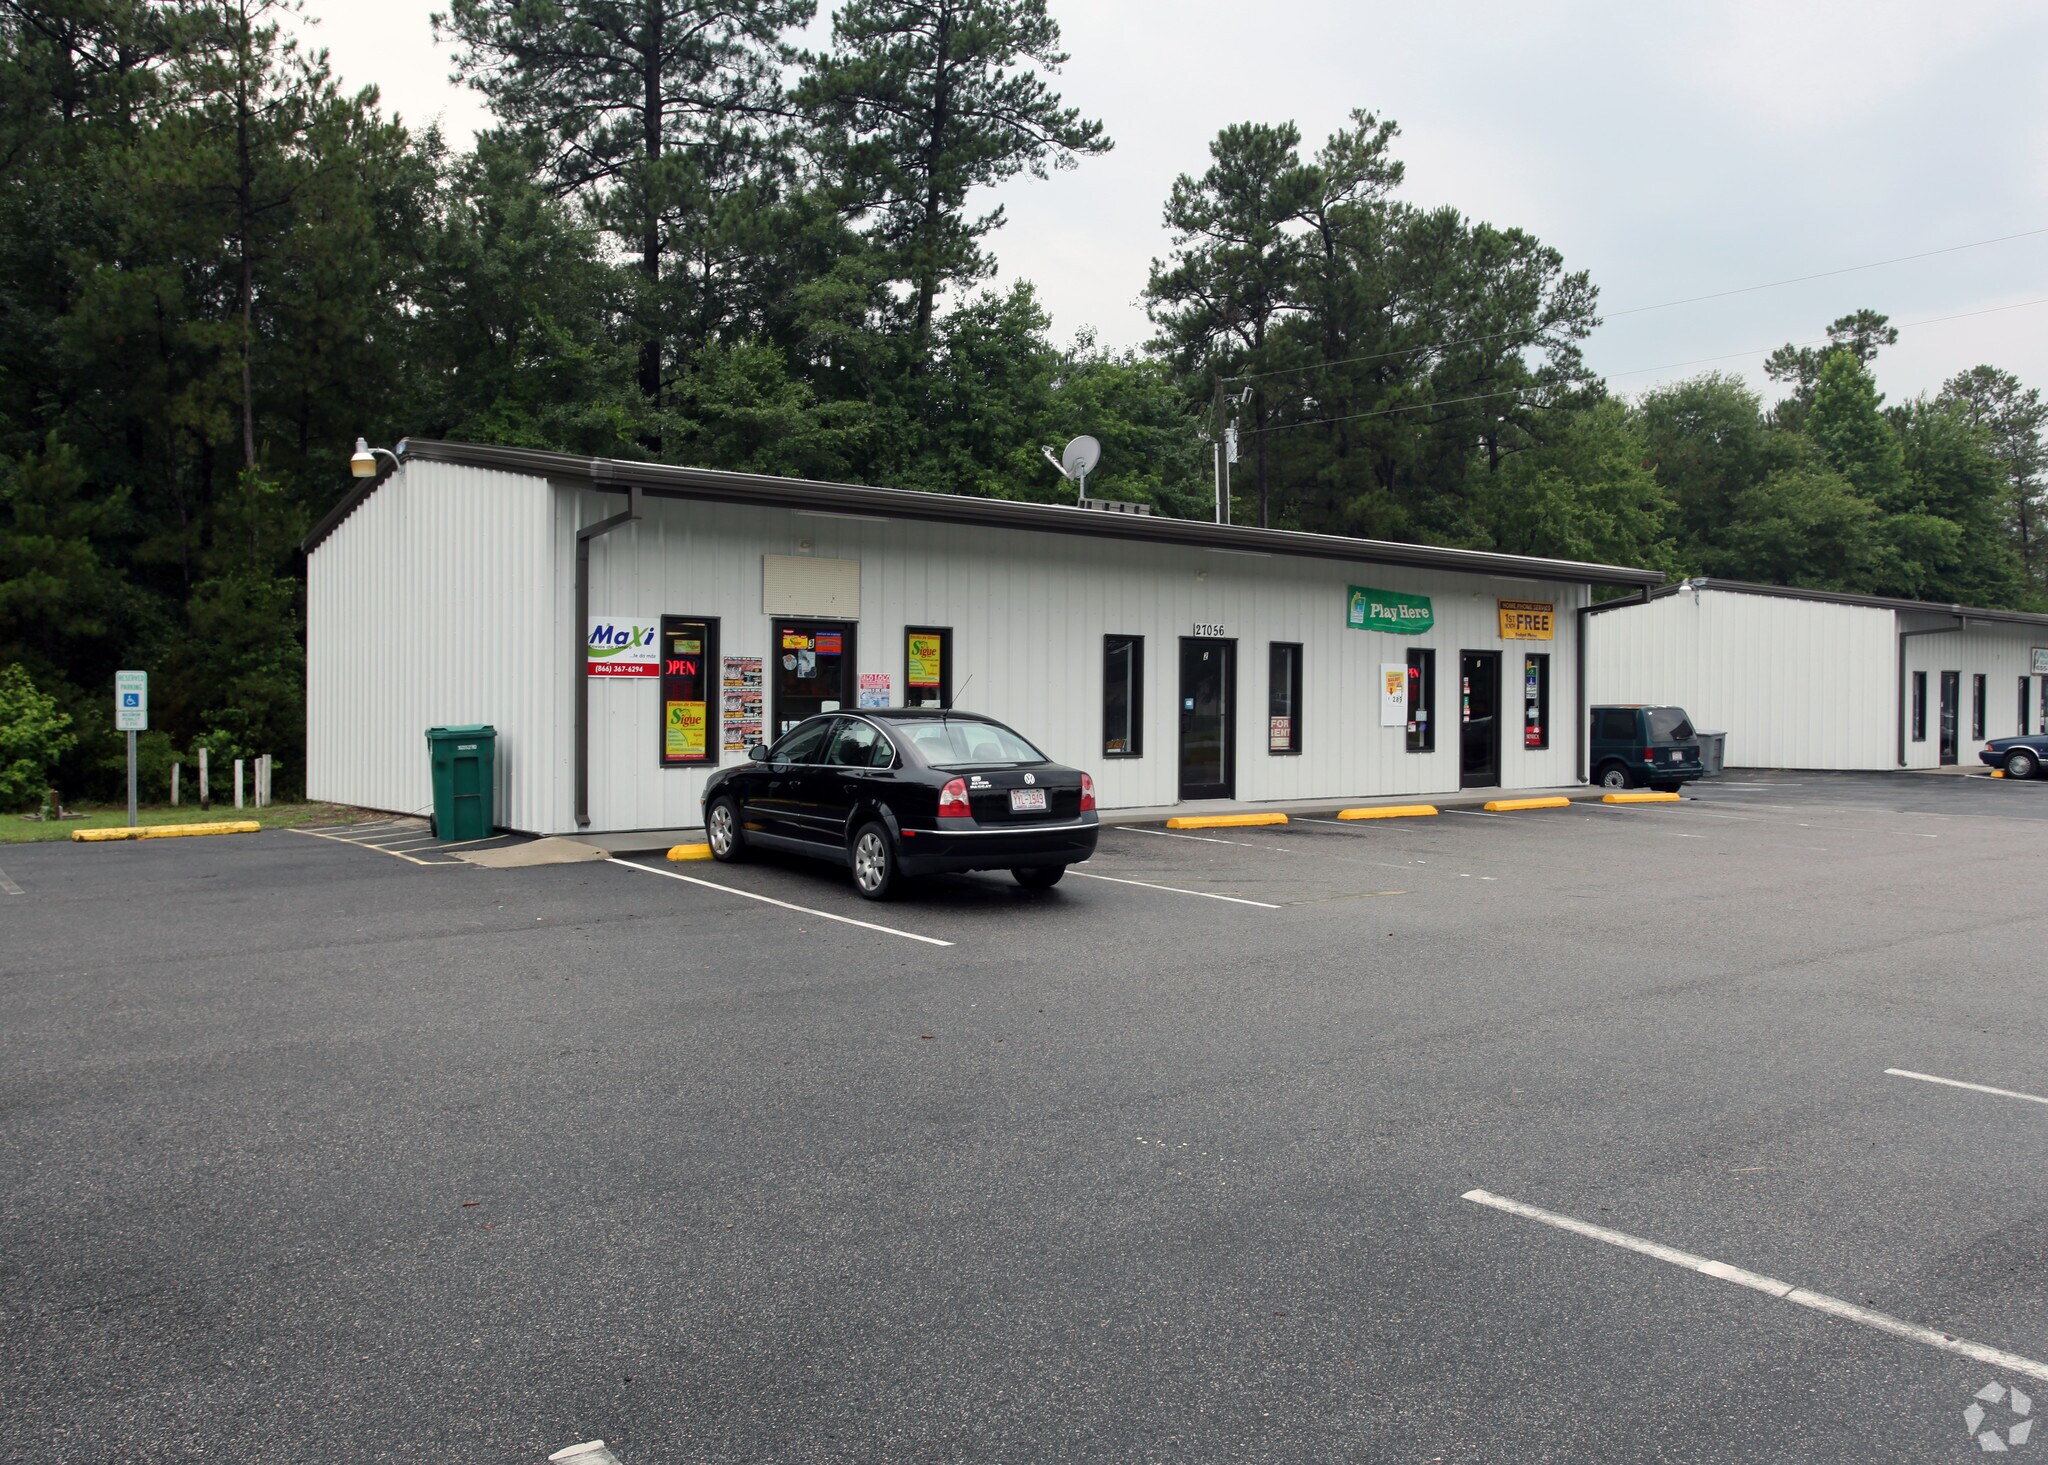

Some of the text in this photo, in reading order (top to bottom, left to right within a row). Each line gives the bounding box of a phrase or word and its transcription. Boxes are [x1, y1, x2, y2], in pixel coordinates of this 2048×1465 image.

[1370, 603, 1398, 622] Play
[1398, 604, 1430, 619] Here
[1196, 624, 1225, 636] 27056
[1516, 614, 1549, 631] FREE
[911, 640, 937, 658] Sigue
[595, 665, 643, 673] (866) 367-6294
[670, 708, 702, 727] Sigue
[1270, 719, 1289, 728] FOR
